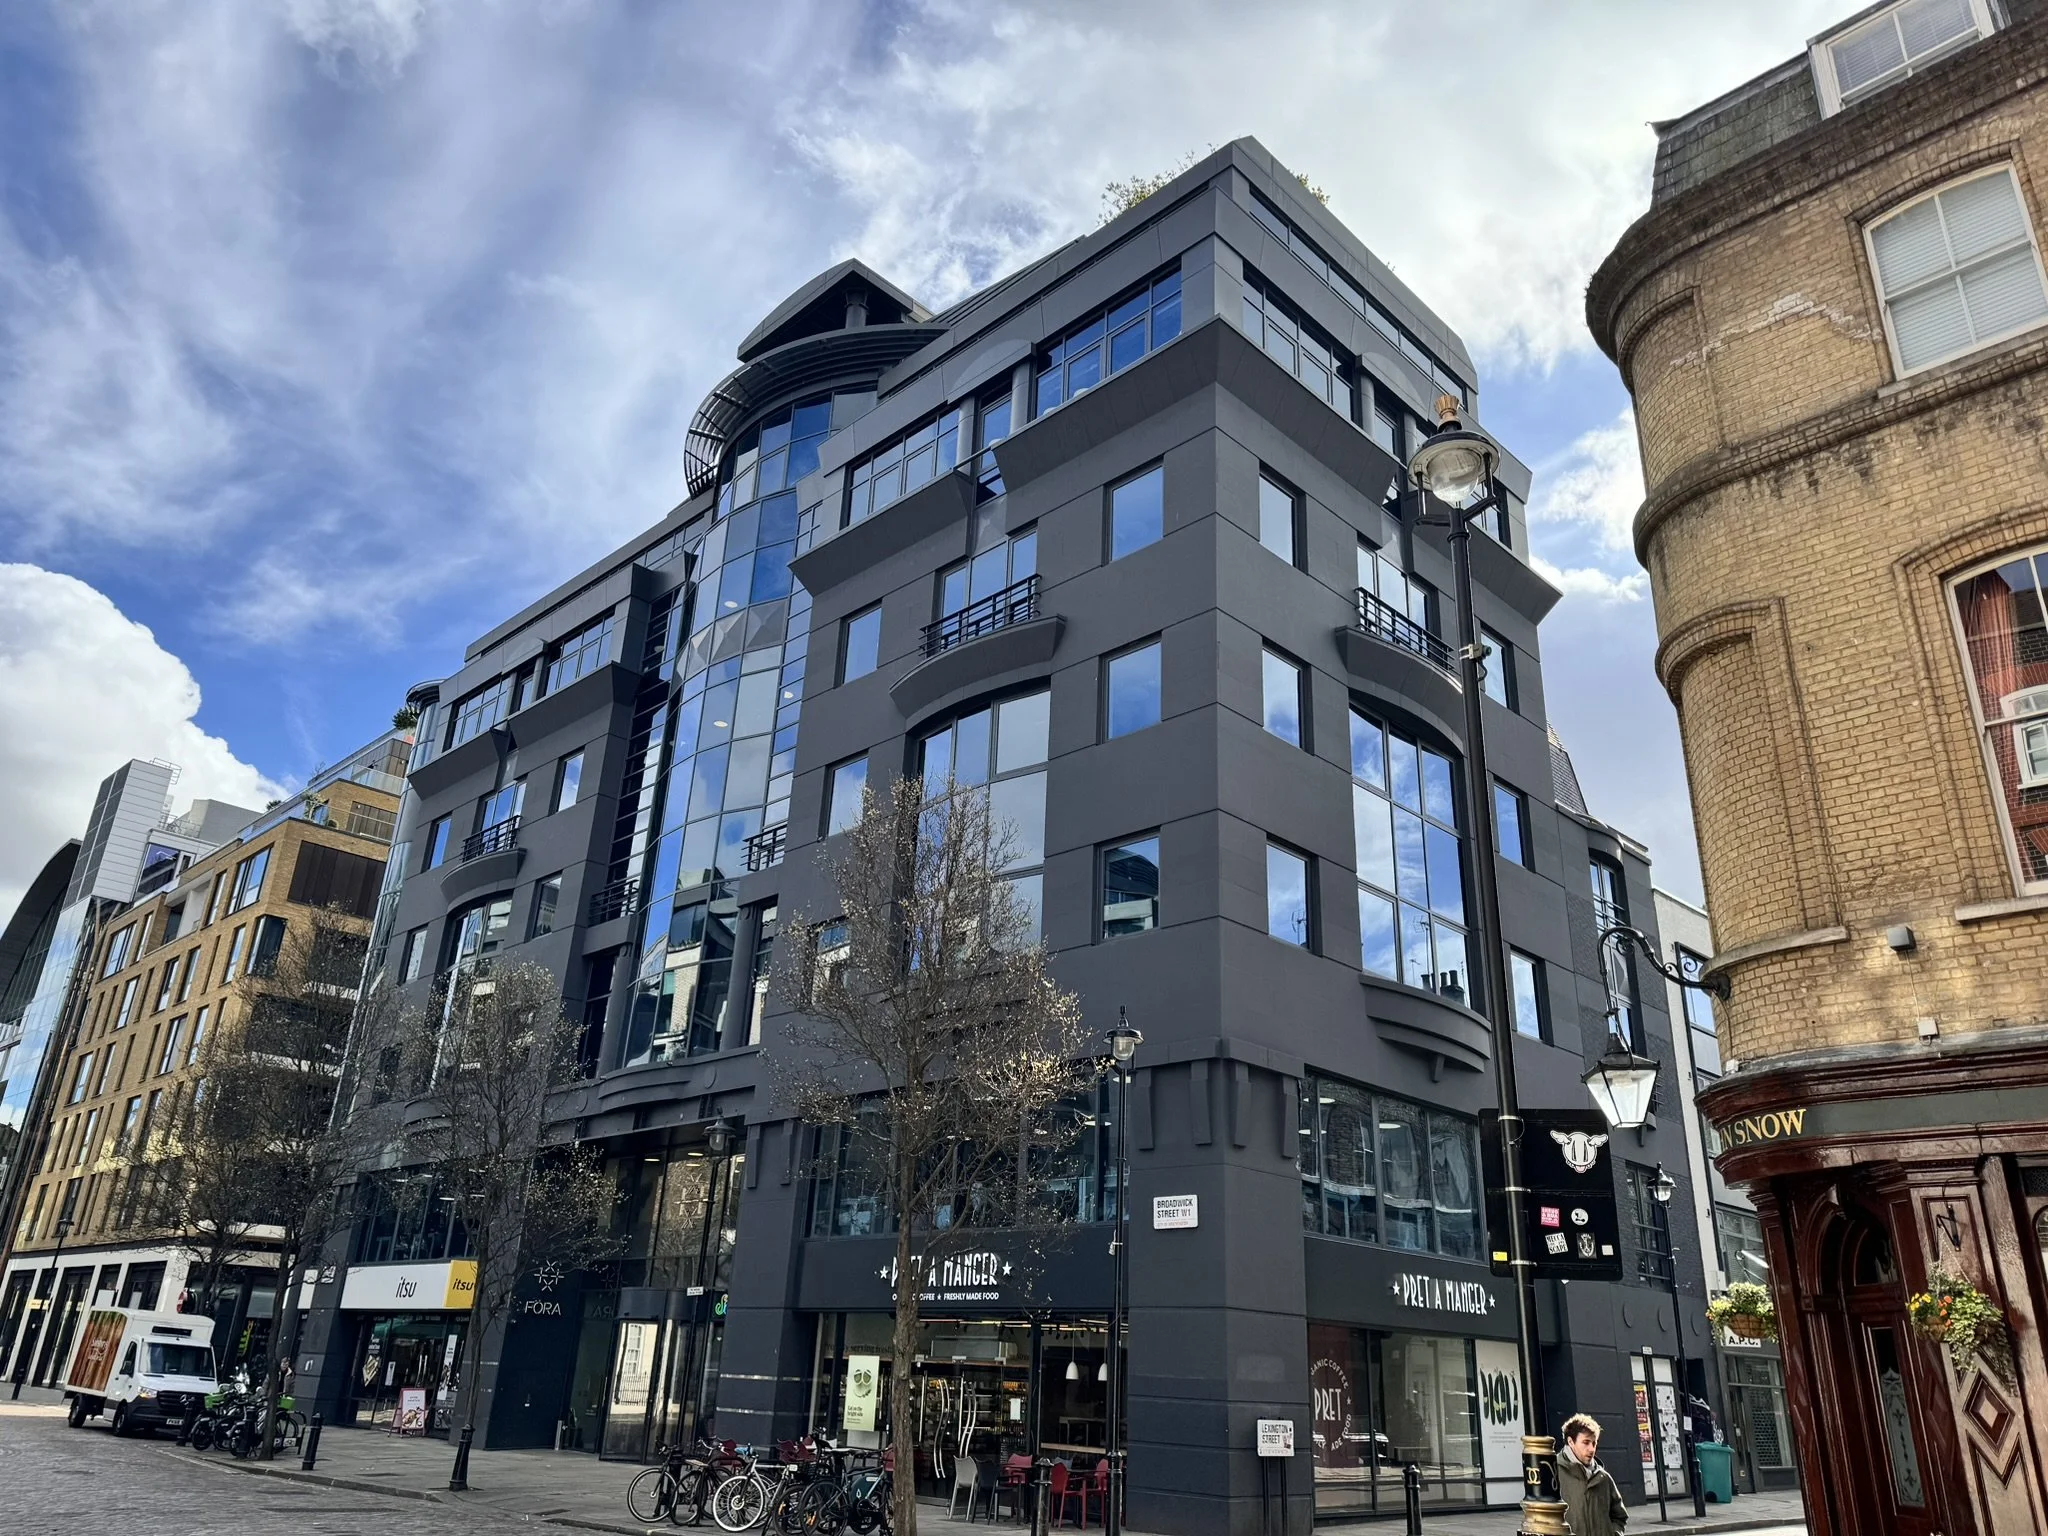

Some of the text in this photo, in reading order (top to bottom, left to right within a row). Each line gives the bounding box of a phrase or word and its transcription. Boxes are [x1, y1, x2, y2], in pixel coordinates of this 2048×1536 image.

[1734, 1108, 1807, 1145] SNOW
[1157, 1199, 1193, 1208] BROADWICK
[1157, 1208, 1191, 1218] STREET W1
[928, 1255, 937, 1287] A
[943, 1252, 998, 1287] MANGER
[396, 1276, 417, 1298] itsu
[452, 1278, 474, 1290] itsu
[944, 1292, 965, 1300] FRESHLY
[966, 1292, 982, 1300] MADE
[982, 1292, 999, 1300] FOOD
[1403, 1273, 1487, 1315] PRET A MANGER
[1728, 1335, 1759, 1346] A.P.C.
[1314, 1388, 1341, 1420] PRET
[1262, 1434, 1280, 1444] STREET
